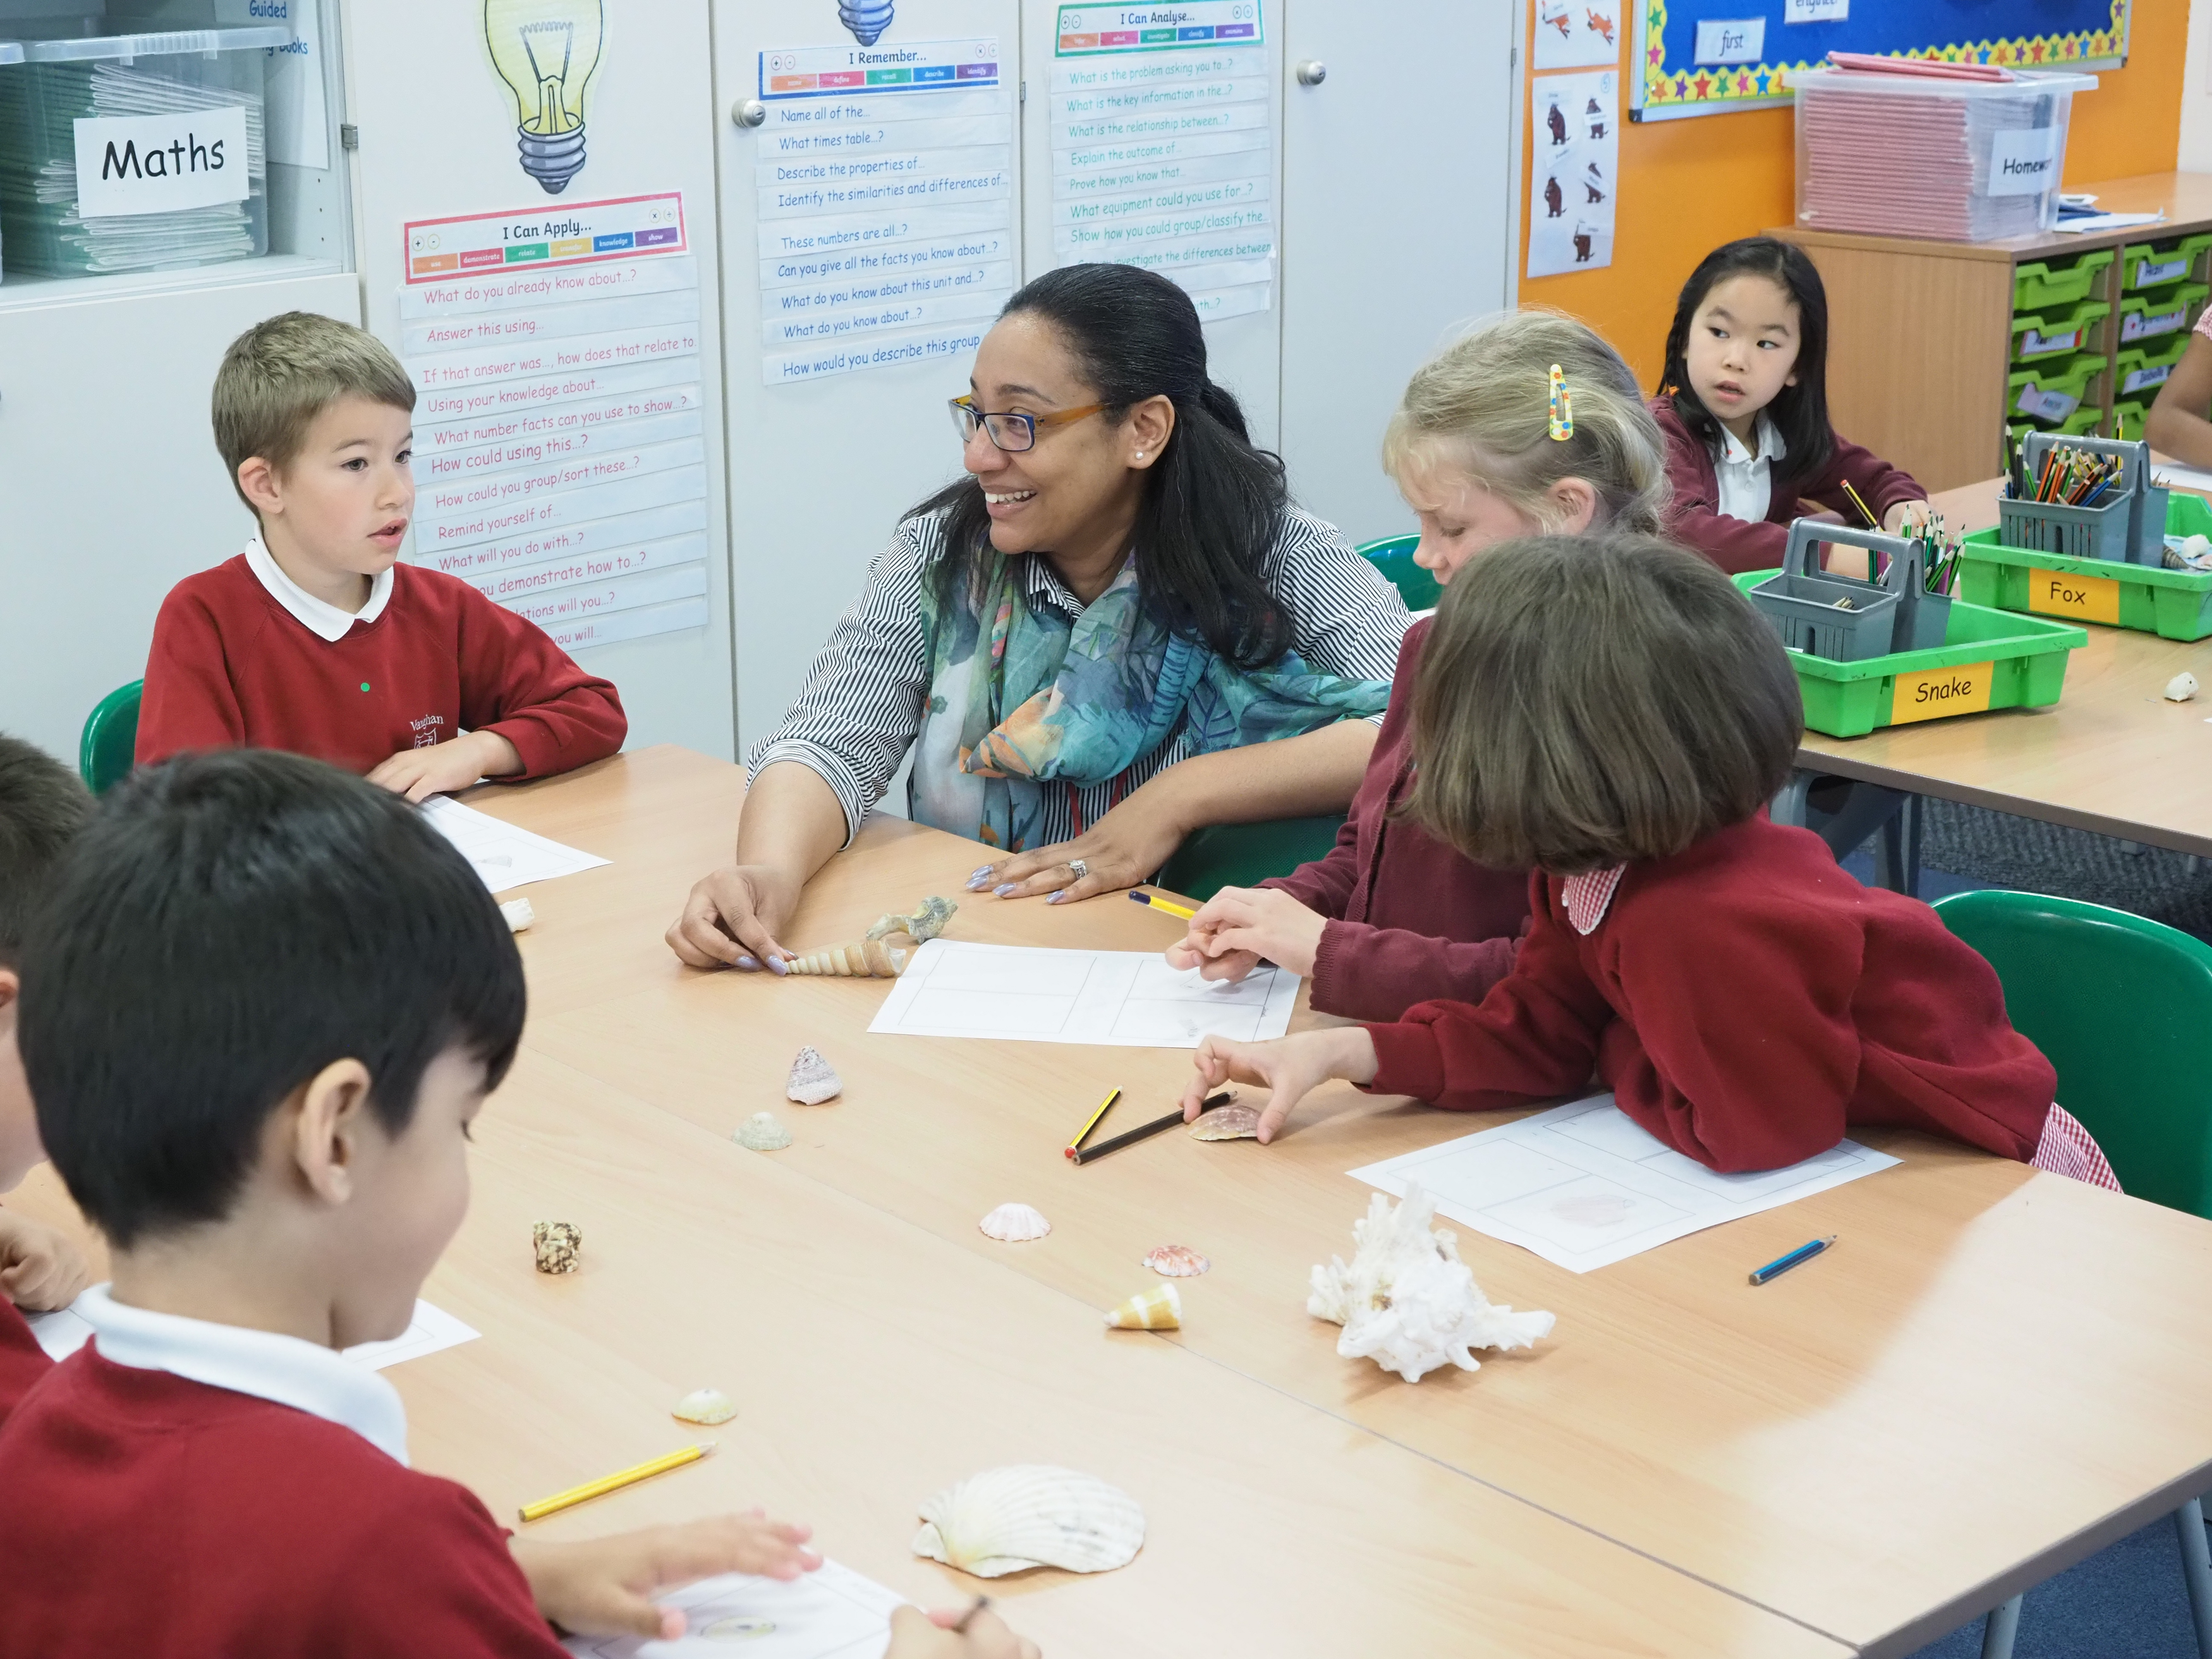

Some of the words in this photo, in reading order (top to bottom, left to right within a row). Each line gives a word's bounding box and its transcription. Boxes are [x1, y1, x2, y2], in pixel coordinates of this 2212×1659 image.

[248, 0, 287, 18] Guided
[1121, 13, 1125, 25] I
[1127, 12, 1148, 24] Can
[1718, 30, 1744, 57] first
[849, 52, 854, 65] I
[1069, 72, 1097, 85] What
[1100, 71, 1108, 82] is
[1110, 69, 1127, 80] the
[1129, 64, 1163, 79] problem
[1165, 62, 1193, 76] asking
[1195, 61, 1211, 73] you
[1066, 100, 1093, 112] What
[1096, 97, 1104, 109] is
[1107, 95, 1122, 107] the
[1124, 94, 1139, 108] key
[1141, 90, 1195, 104] information
[1196, 88, 1205, 98] in
[781, 108, 811, 123] Name
[814, 106, 827, 120] all
[829, 105, 841, 119] of
[1068, 126, 1095, 137] What
[1097, 124, 1105, 135] is
[1107, 122, 1124, 134] the
[1126, 117, 1179, 133] relationship
[779, 136, 810, 150] What
[813, 134, 842, 147] times
[102, 132, 225, 181] Maths
[1071, 152, 1106, 167] Explain
[1108, 150, 1124, 161] the
[1126, 146, 1164, 159] outcome
[777, 164, 826, 181] Describe
[829, 162, 846, 176] the
[849, 159, 904, 177] properties
[1069, 178, 1097, 190] Prove
[1098, 176, 1117, 187] how
[1119, 174, 1134, 187] you
[1136, 170, 1158, 182] know
[778, 190, 824, 207] Identify
[827, 188, 845, 202] the
[848, 183, 904, 201] similarities
[907, 178, 926, 195] and
[928, 176, 988, 192] differences
[1070, 205, 1100, 218] What
[1102, 198, 1153, 215] equipment
[1155, 191, 1183, 207] could
[1185, 191, 1203, 204] you
[1205, 190, 1222, 200] use
[503, 226, 509, 240] I
[513, 224, 540, 238] Can
[648, 233, 664, 241] show
[781, 235, 815, 250] These
[817, 231, 860, 246] numbers
[862, 228, 880, 239] are
[1071, 229, 1100, 243] Show
[1103, 228, 1123, 240] how
[1126, 226, 1143, 241] you
[1145, 221, 1170, 236] could
[1173, 211, 1244, 236] group/classify
[778, 264, 797, 277] Can
[799, 264, 818, 278] you
[820, 261, 842, 277] give
[844, 256, 857, 270] all
[860, 255, 878, 267] the
[882, 252, 908, 267] facts
[911, 252, 928, 265] you
[930, 246, 955, 260] know
[1165, 252, 1180, 262] the
[1182, 246, 1234, 260] differences
[1236, 242, 1272, 255] between
[424, 290, 460, 305] What
[464, 288, 480, 301] do
[482, 286, 504, 302] you
[507, 279, 552, 296] already
[555, 275, 585, 289] know
[781, 295, 811, 309] What
[814, 292, 827, 305] do
[830, 291, 849, 307] you
[851, 285, 877, 299] know
[880, 281, 908, 296] about
[911, 279, 930, 291] this
[933, 275, 952, 288] unit
[427, 327, 473, 343] Answer
[477, 324, 501, 337] this
[784, 324, 815, 339] What
[817, 321, 830, 333] do
[832, 320, 851, 335] you
[853, 315, 878, 328] know
[423, 369, 437, 384] If
[442, 366, 470, 381] that
[474, 362, 516, 377] answer
[557, 350, 581, 366] how
[584, 348, 612, 362] does
[616, 344, 640, 358] that
[643, 337, 679, 355] relate
[783, 362, 810, 377] How
[813, 354, 845, 372] would
[848, 354, 869, 370] you
[872, 345, 923, 363] describe
[926, 339, 947, 355] this
[949, 334, 980, 354] group
[428, 398, 464, 415] Using
[466, 395, 495, 410] your
[499, 384, 559, 403] knowledge
[434, 429, 470, 446] What
[473, 425, 517, 441] number
[522, 418, 554, 433] facts
[557, 414, 578, 427] can
[580, 410, 602, 427] you
[604, 406, 624, 420] use
[627, 402, 640, 416] to
[431, 457, 461, 475] How
[466, 449, 502, 469] could
[506, 445, 542, 463] using
[435, 493, 463, 509] How
[467, 485, 498, 504] could
[500, 482, 521, 499] you
[523, 466, 590, 489] group/sort
[438, 519, 484, 540] Remind
[487, 507, 536, 535] yourself
[439, 554, 473, 571] What
[477, 549, 497, 564] will
[500, 547, 522, 562] you
[525, 541, 539, 554] do
[498, 566, 583, 593] demonstrate
[586, 561, 612, 576] how
[558, 597, 577, 612] will
[2050, 581, 2086, 605] Fox
[1914, 676, 1972, 703] Snake
[409, 714, 444, 732] Vaughan
